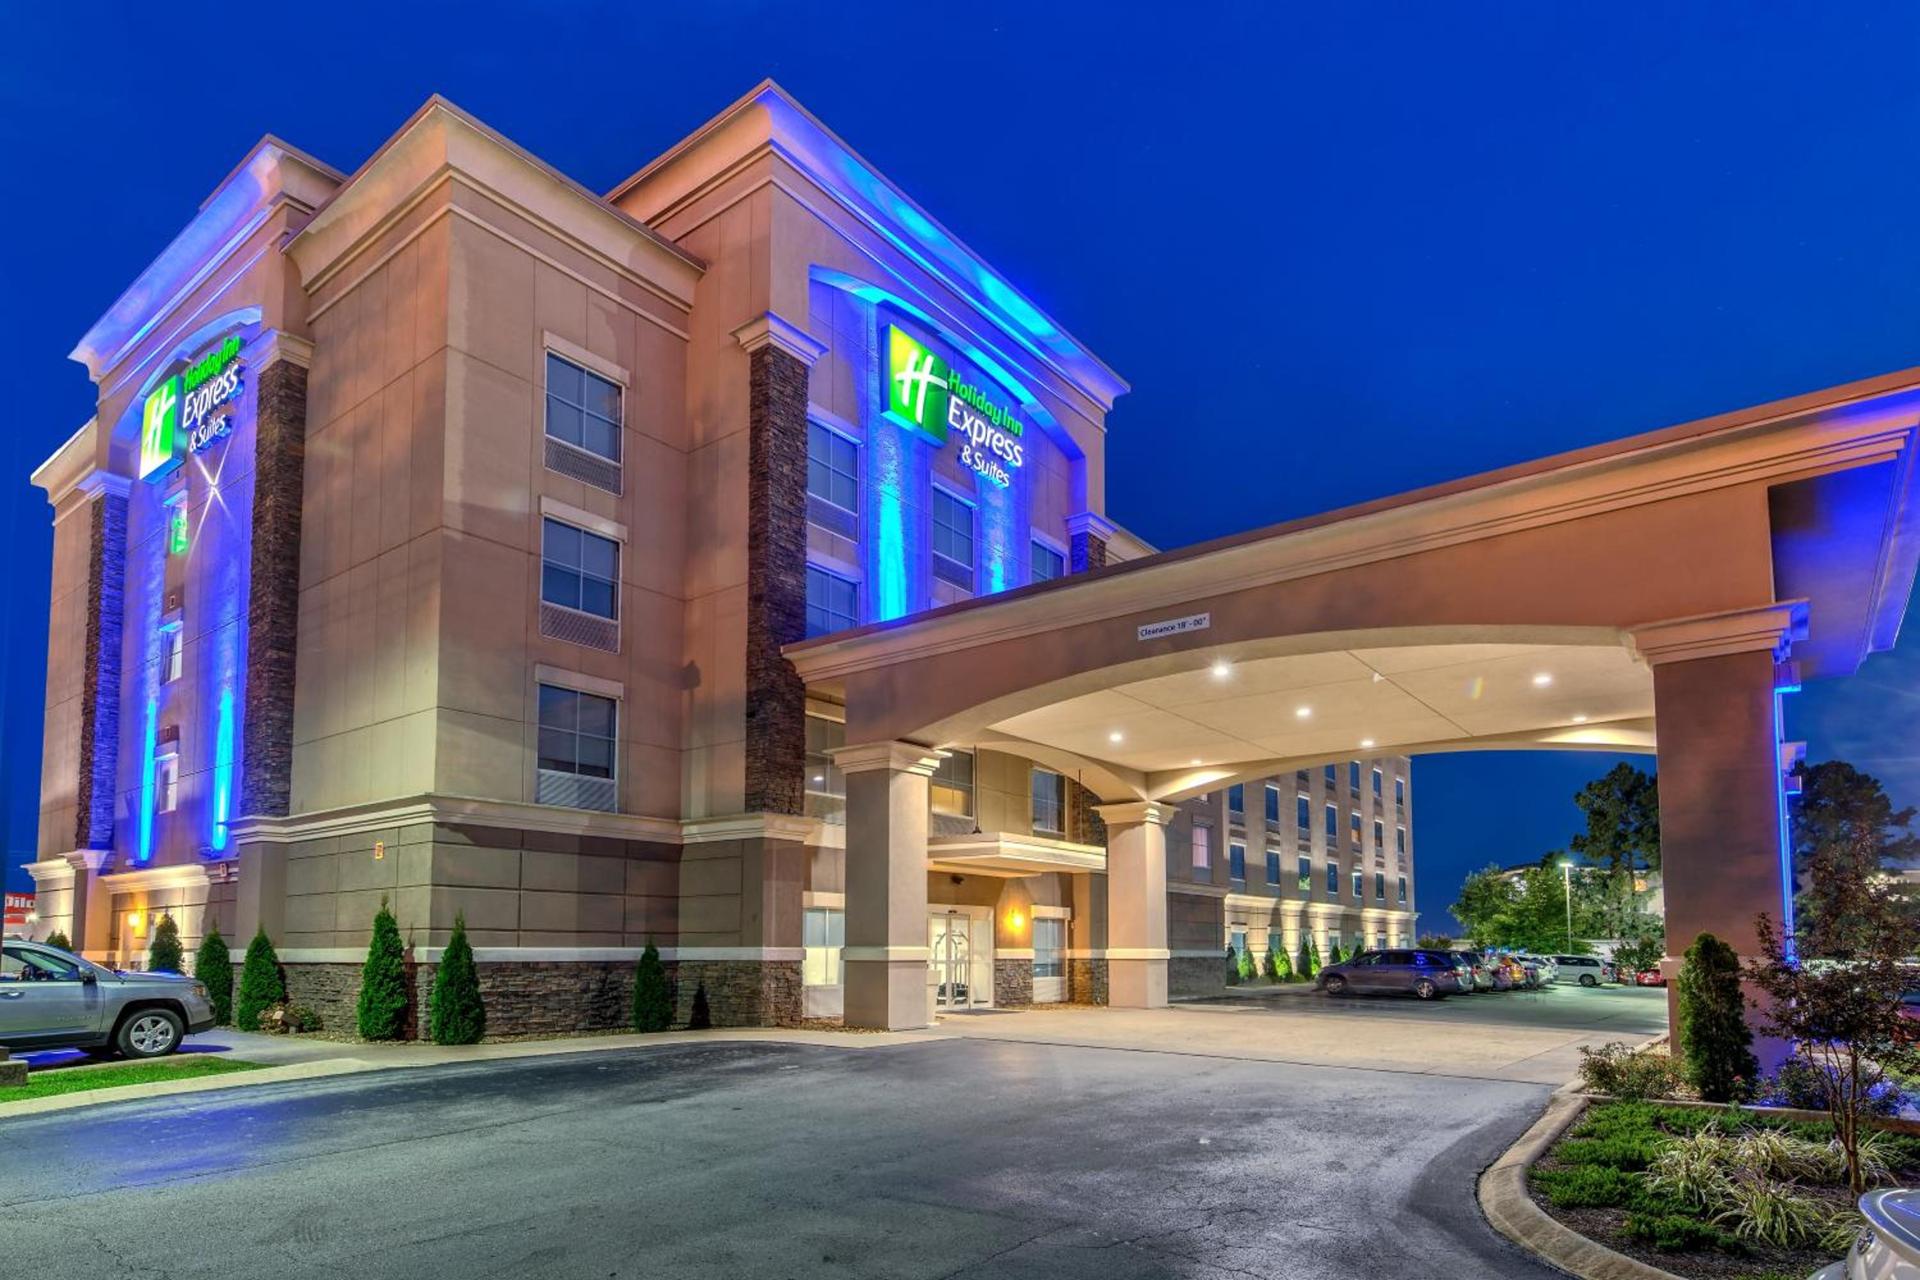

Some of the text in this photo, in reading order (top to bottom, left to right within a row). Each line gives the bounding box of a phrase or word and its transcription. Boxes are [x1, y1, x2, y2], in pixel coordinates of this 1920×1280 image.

[183, 364, 238, 428] Express
[949, 369, 1023, 437] Holiday Inn
[190, 414, 226, 453] & Suites
[948, 395, 1023, 467] Express
[961, 445, 1010, 488] & Suites
[1140, 626, 1176, 637] Clearance
